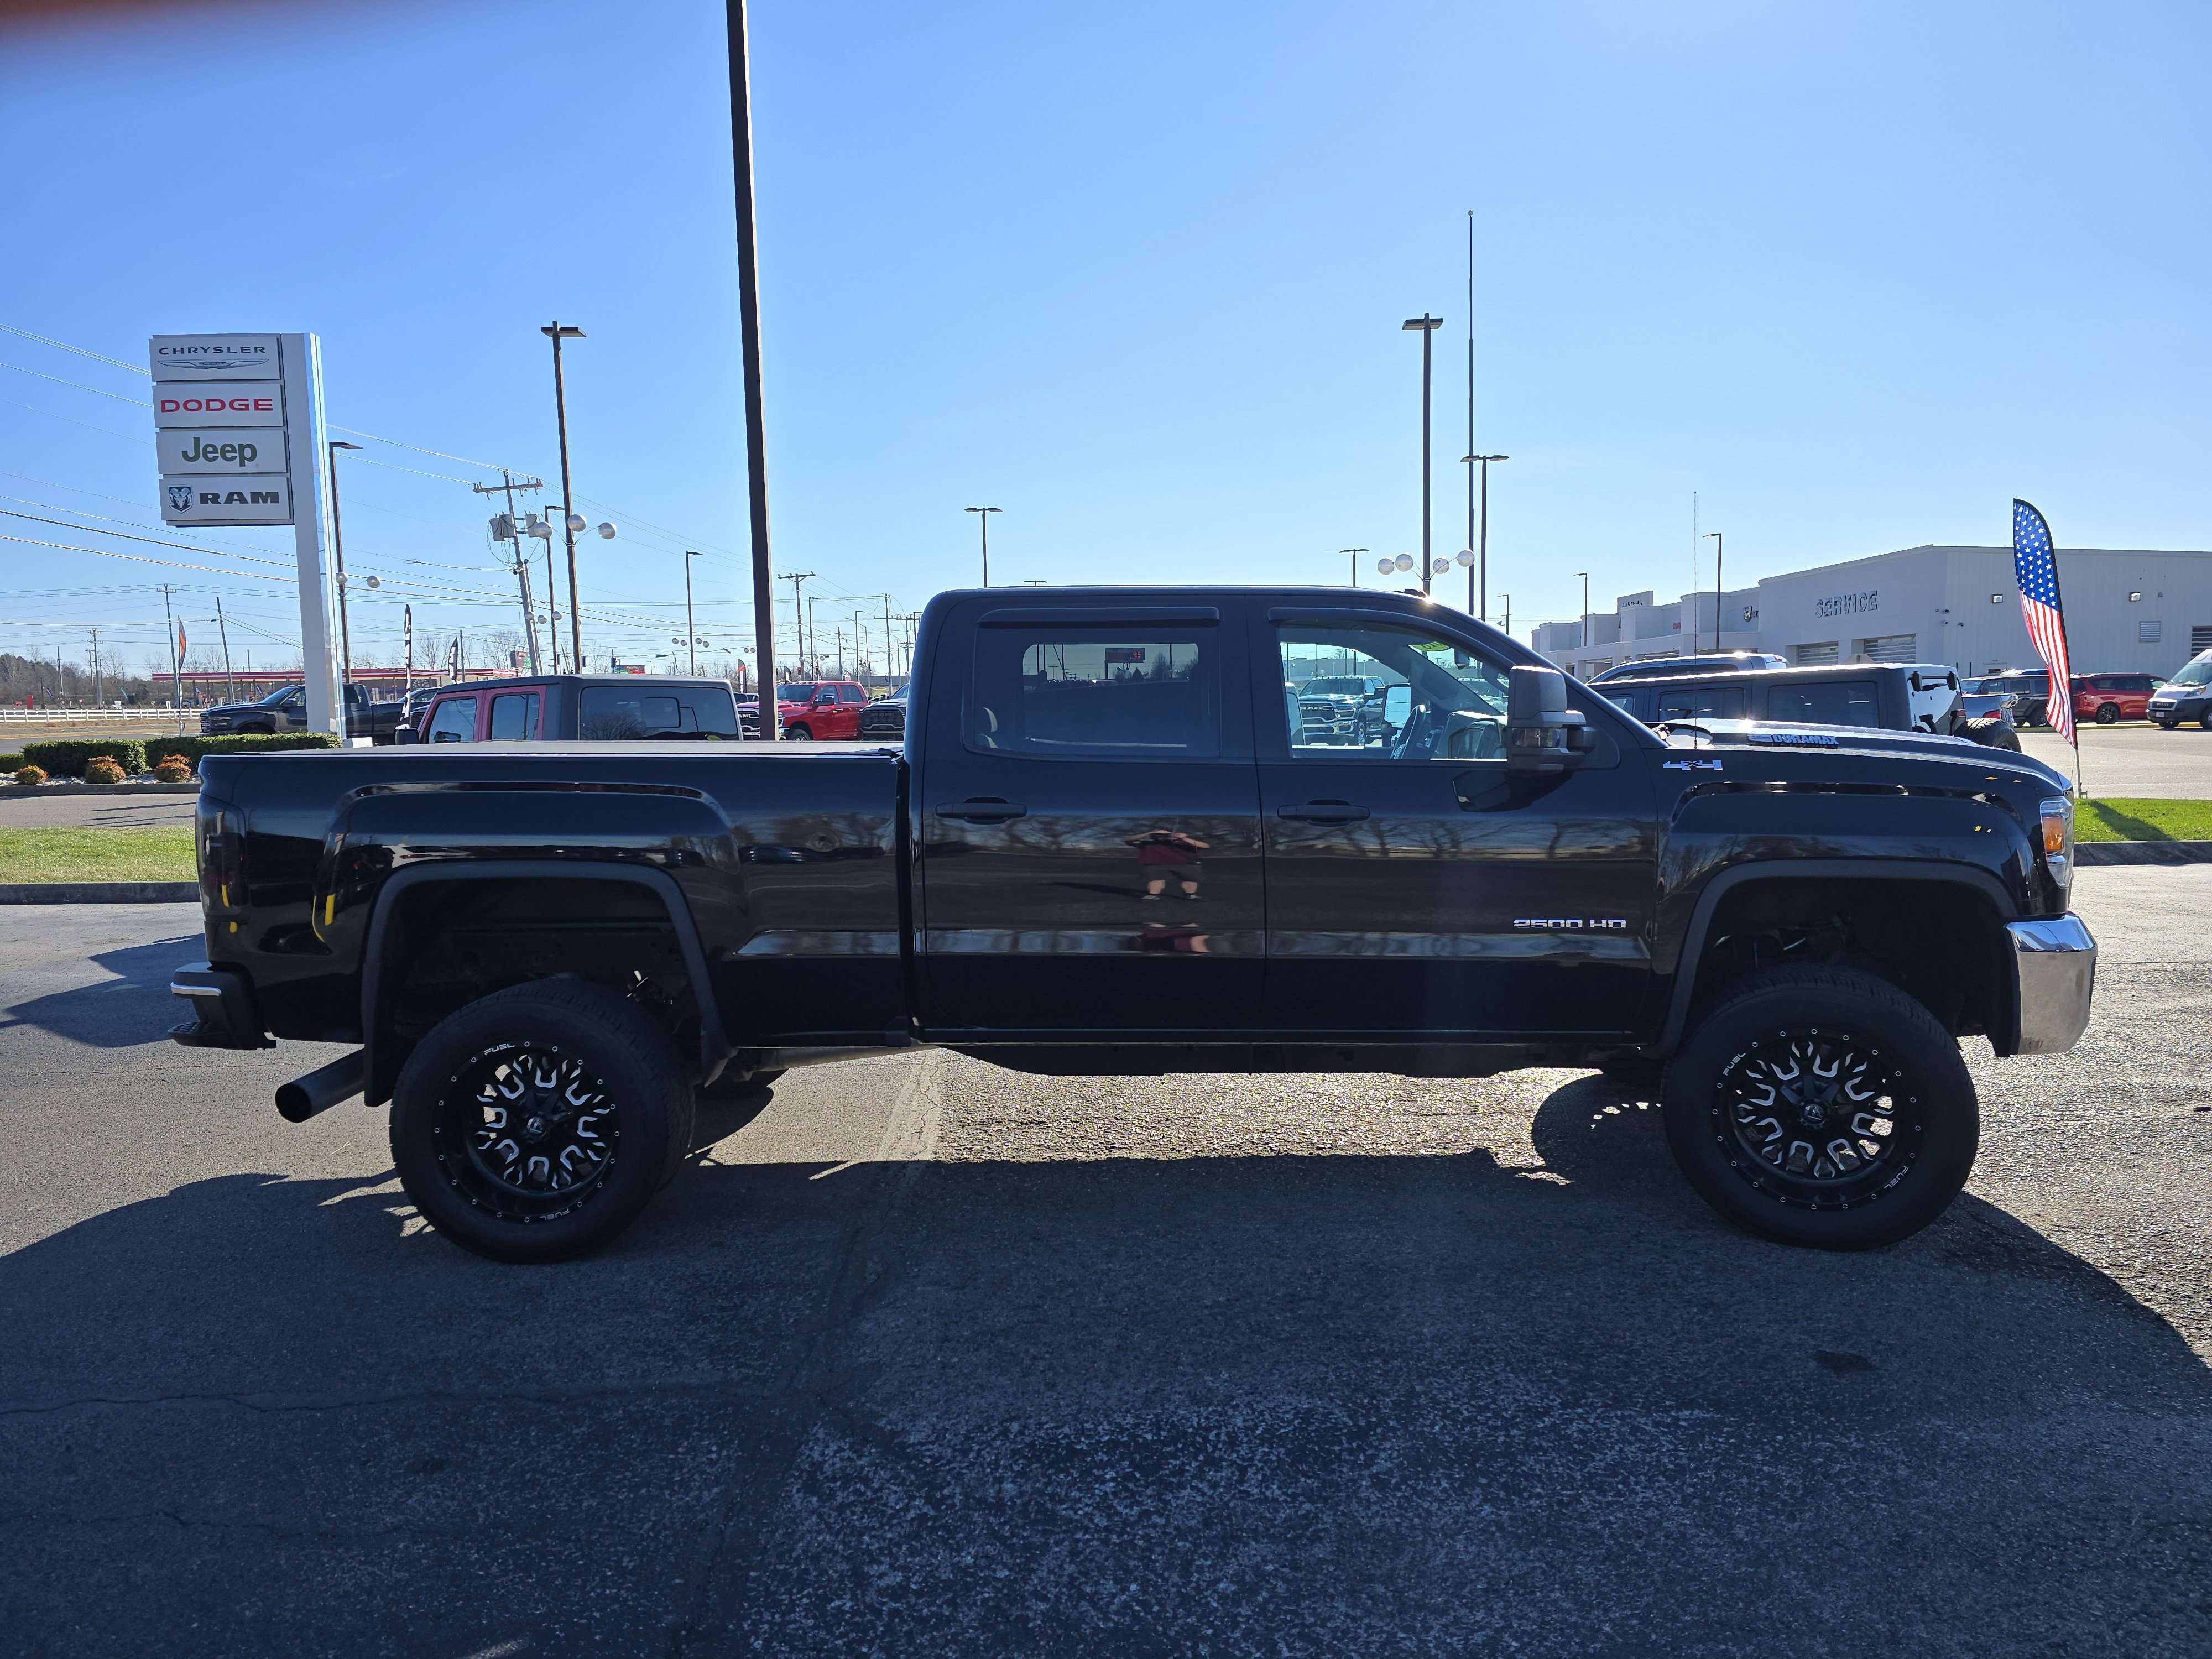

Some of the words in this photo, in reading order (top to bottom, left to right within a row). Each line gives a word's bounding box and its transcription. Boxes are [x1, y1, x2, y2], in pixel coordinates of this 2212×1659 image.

[159, 346, 266, 355] CHRYSLER
[160, 398, 273, 413] DODGE
[181, 436, 257, 467] Jeep
[199, 492, 279, 505] RAM
[1815, 590, 1878, 618] SERVICE
[1773, 734, 1839, 745] DURAMAX
[1514, 919, 1583, 928] 2500
[1589, 919, 1626, 928] HD
[483, 1043, 515, 1056] FUEL
[1723, 1052, 1746, 1076] FUEL
[1883, 1165, 1909, 1189] FUEL
[539, 1208, 570, 1220] FUEL
